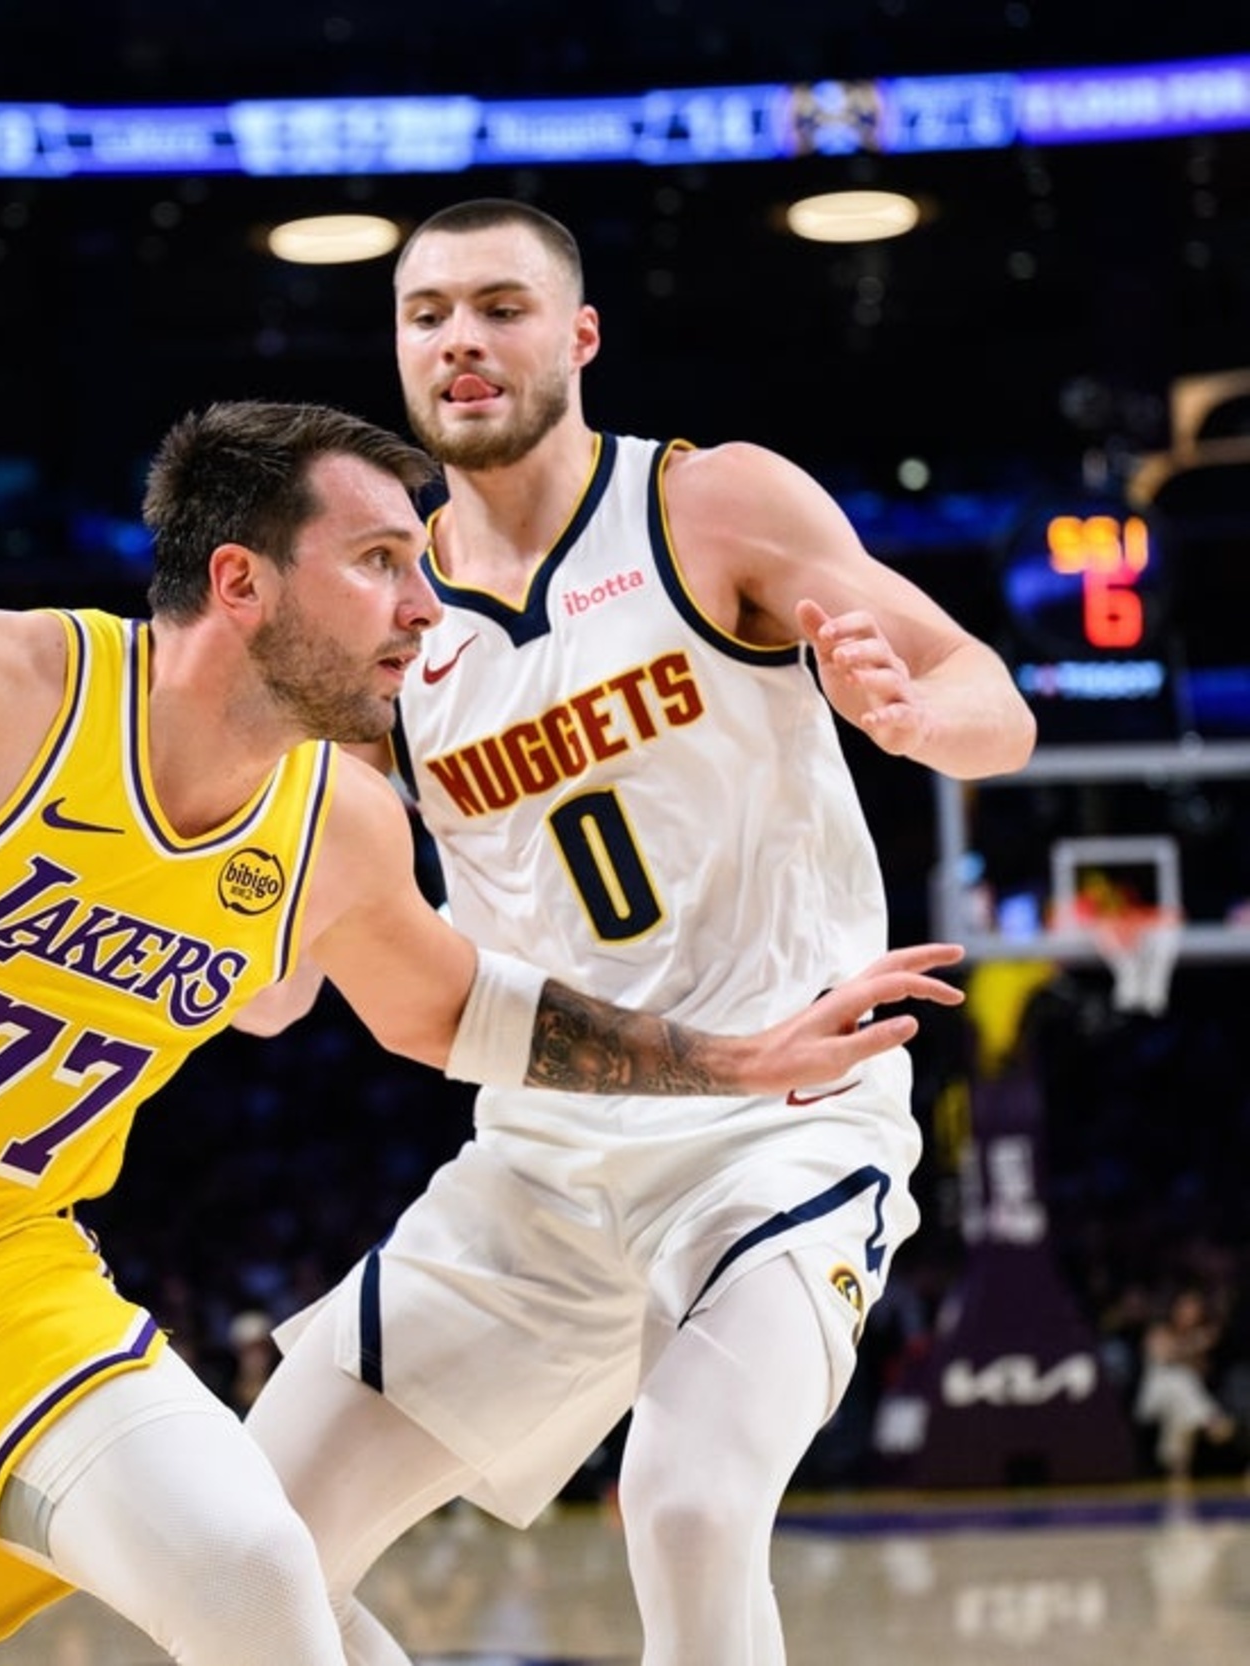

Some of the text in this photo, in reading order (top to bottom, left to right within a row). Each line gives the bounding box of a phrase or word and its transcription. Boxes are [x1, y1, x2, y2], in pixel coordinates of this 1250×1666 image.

[563, 569, 644, 616] ibotta
[424, 649, 704, 818] NUGGETS
[226, 862, 279, 899] bibigo
[545, 785, 668, 946] 0
